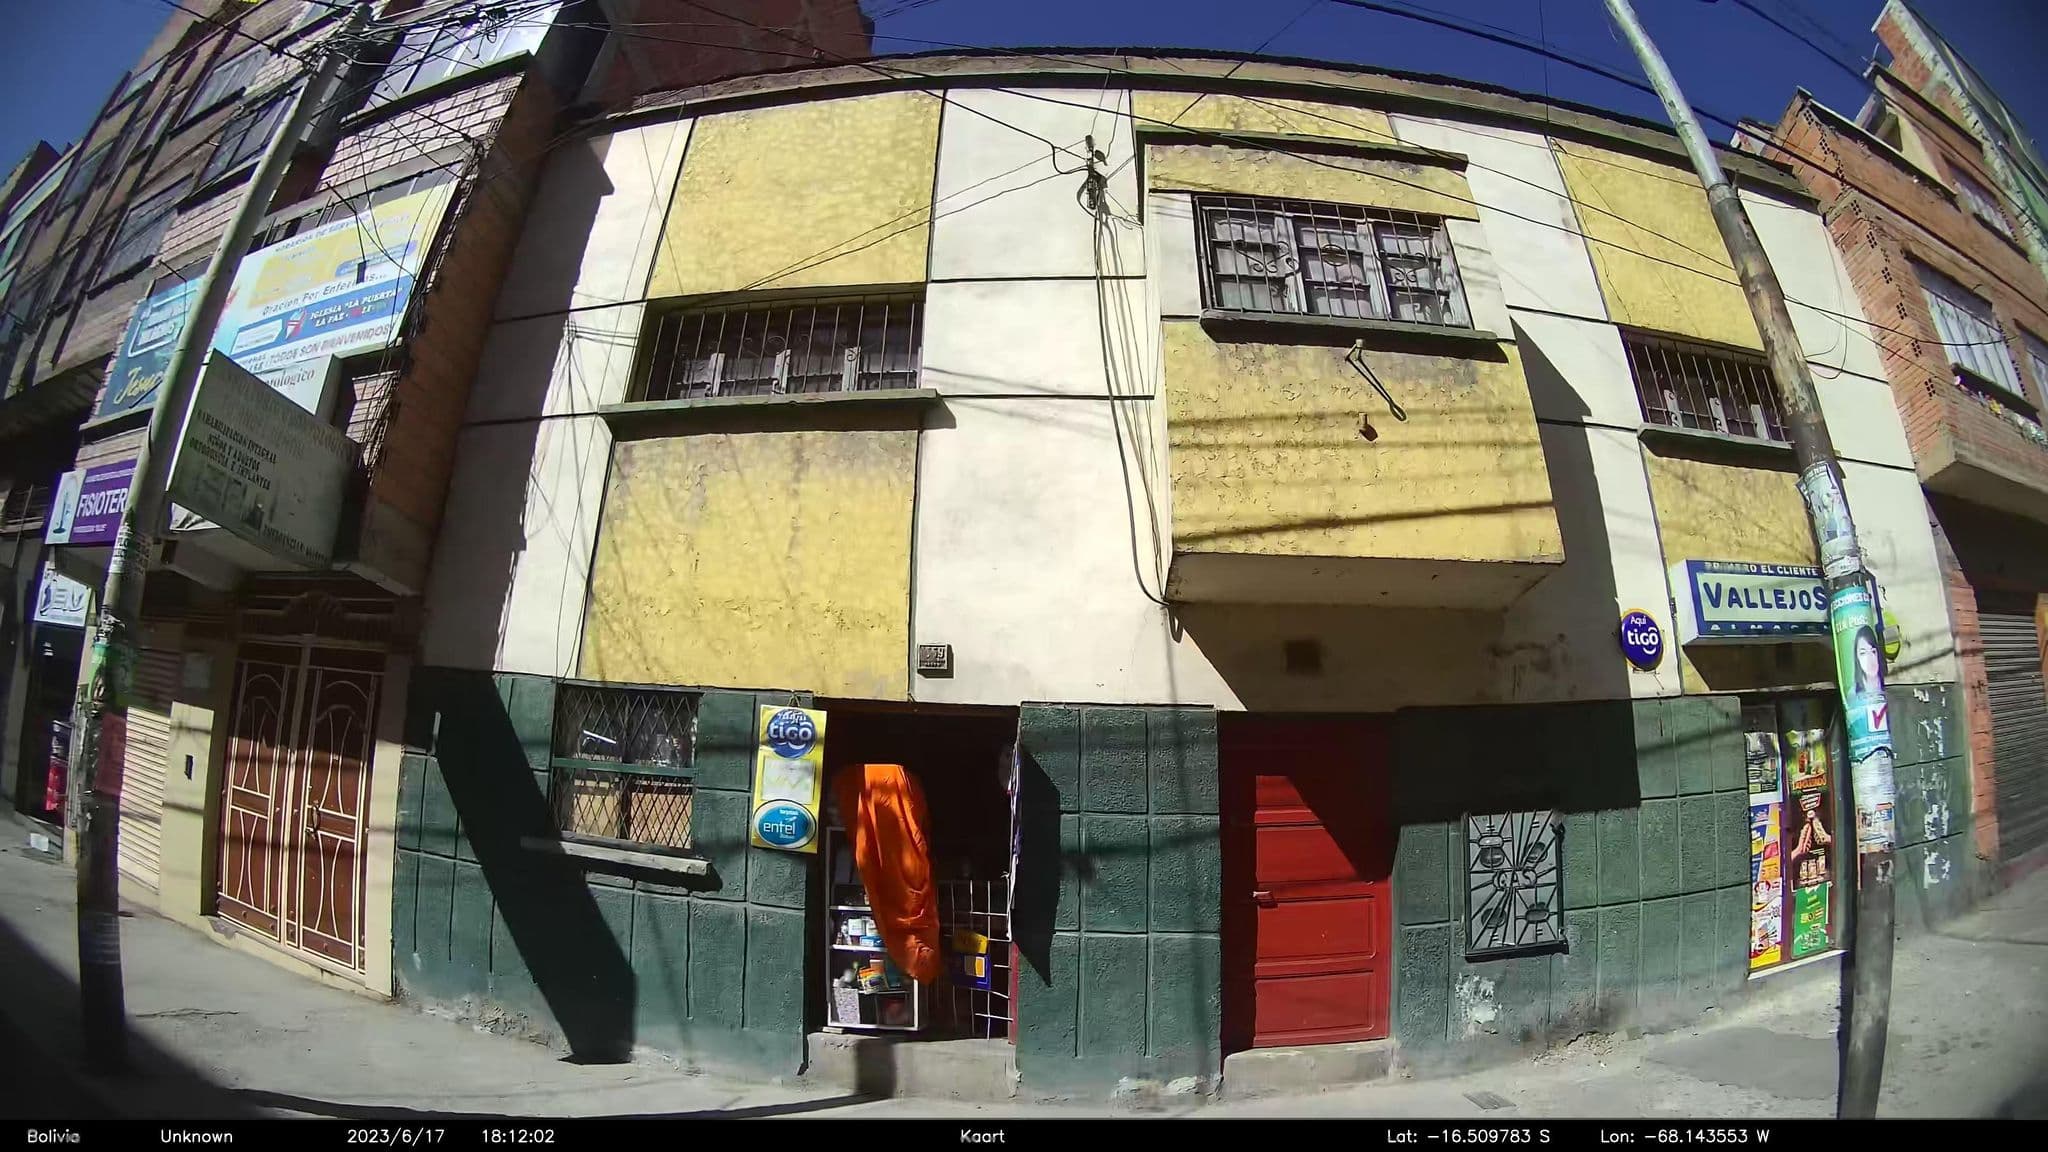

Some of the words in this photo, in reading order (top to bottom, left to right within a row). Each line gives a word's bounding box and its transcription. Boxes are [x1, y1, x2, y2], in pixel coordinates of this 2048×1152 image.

[1762, 565, 1775, 573] EL
[1776, 566, 1818, 576] CLIENTE
[1703, 582, 1829, 610] VALLEJOS
[1627, 626, 1659, 646] tigo
[769, 721, 813, 743] tigo
[763, 820, 796, 836] entel
